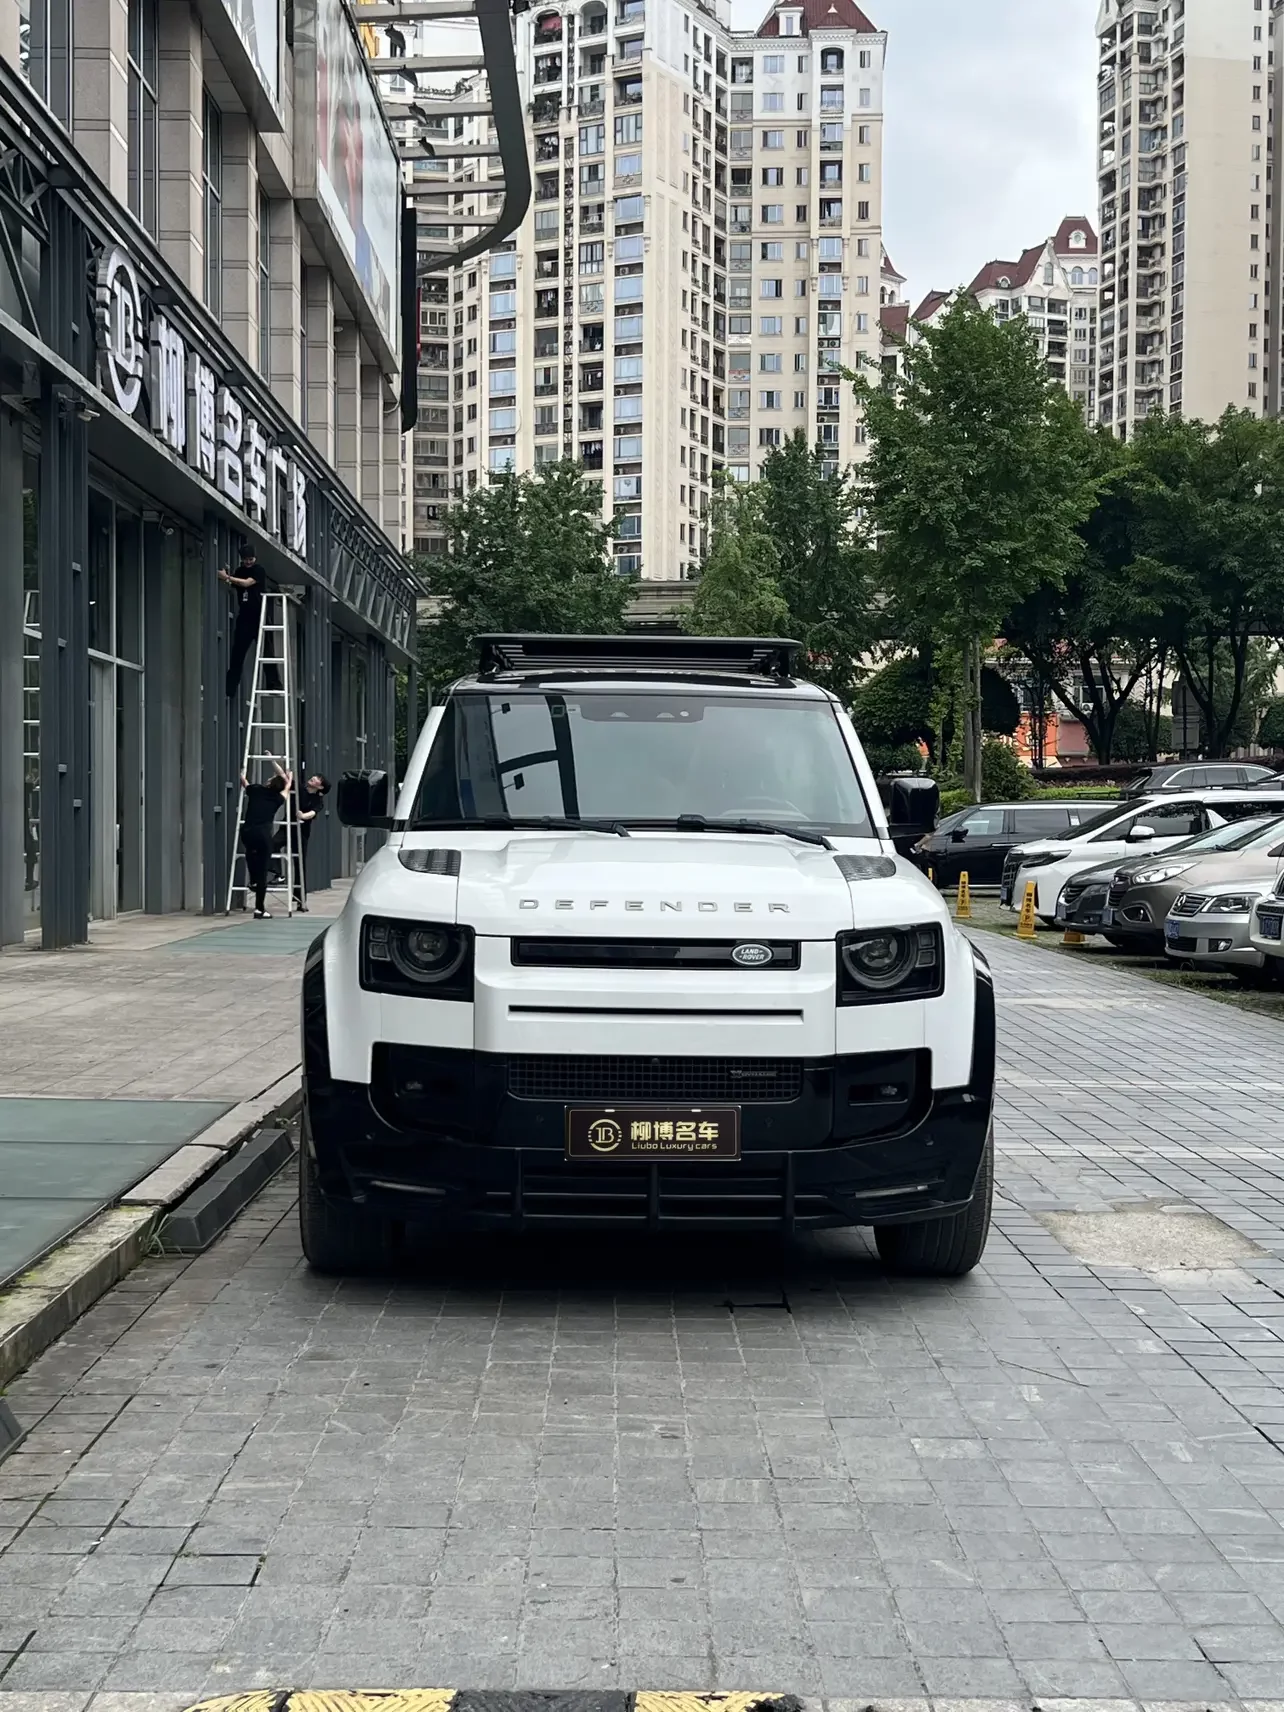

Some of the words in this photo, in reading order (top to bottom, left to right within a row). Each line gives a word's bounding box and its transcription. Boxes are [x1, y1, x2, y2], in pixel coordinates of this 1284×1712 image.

[519, 899, 790, 913] DEFENDER
[630, 1121, 719, 1141] 柳博名车
[631, 1142, 658, 1150] Liubo
[660, 1142, 694, 1151] Luxury
